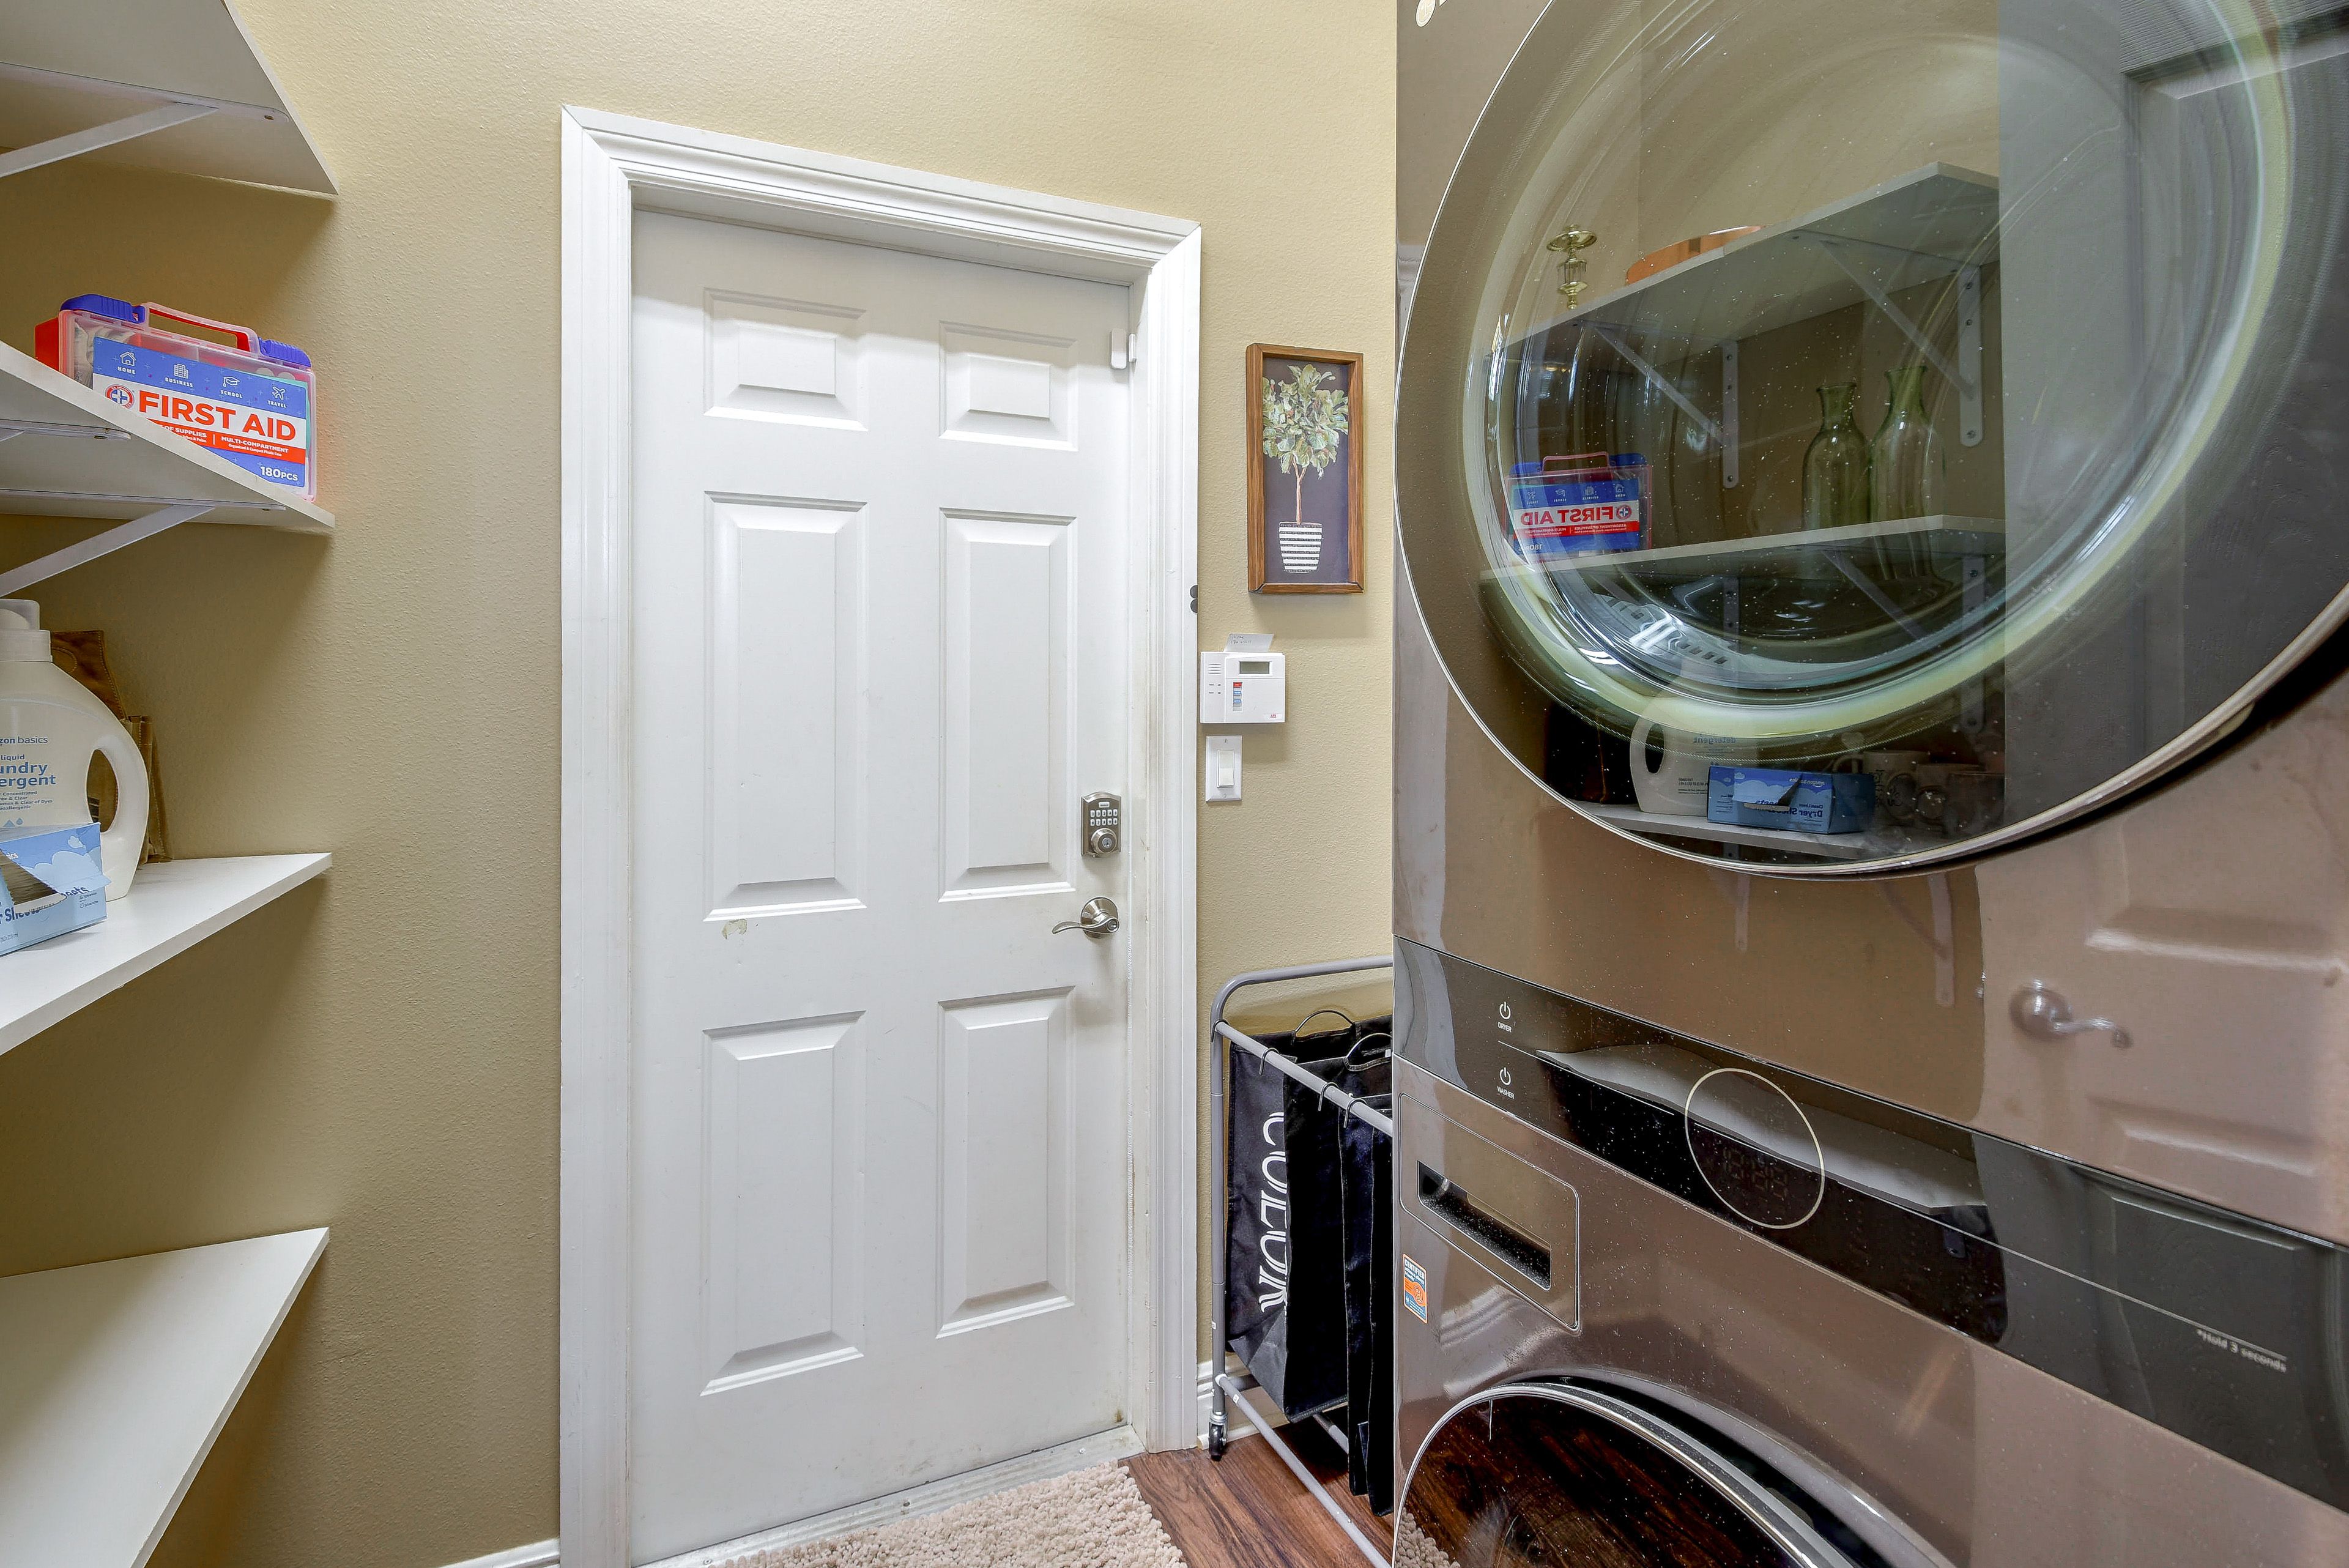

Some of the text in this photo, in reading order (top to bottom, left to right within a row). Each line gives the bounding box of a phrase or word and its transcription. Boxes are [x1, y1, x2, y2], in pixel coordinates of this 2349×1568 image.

[117, 366, 136, 374] HOME
[165, 377, 193, 388] BUSINESS
[220, 390, 243, 399] SCHOOL
[267, 400, 287, 409] TRAVEL
[139, 390, 296, 440] FIRST AID
[175, 428, 207, 438] SUPPLIES
[221, 436, 289, 453] MULTI-COMPARTMENT
[260, 466, 299, 481] 180PCS
[1498, 1021, 1512, 1033] DRYER
[1497, 1085, 1515, 1099] WASHER
[2230, 1341, 2239, 1353] 3
[2241, 1347, 2287, 1373] seconds
